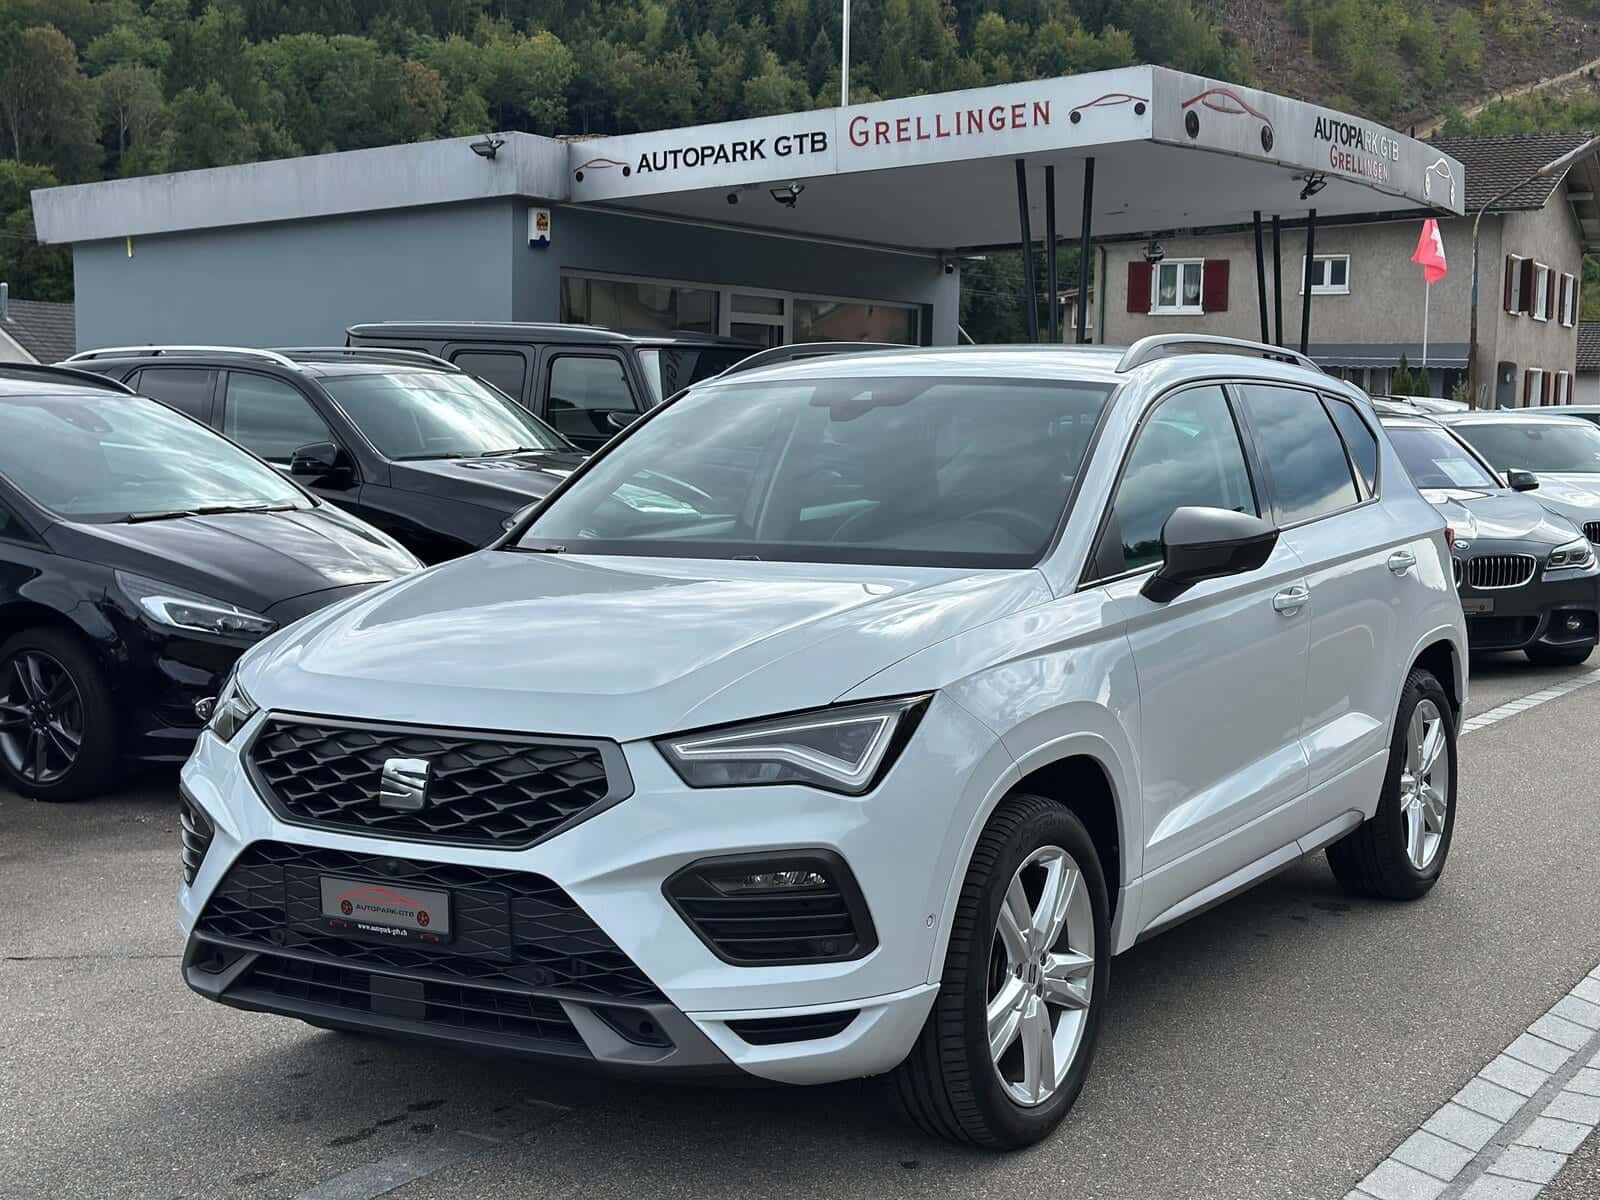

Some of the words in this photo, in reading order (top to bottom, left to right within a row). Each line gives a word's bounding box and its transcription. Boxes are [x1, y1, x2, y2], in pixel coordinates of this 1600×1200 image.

[849, 100, 1051, 147] GRELLINGEN
[1313, 116, 1378, 154] AUTOPARK
[1380, 136, 1399, 161] GTB
[636, 138, 766, 174] AUTOPARK
[773, 131, 828, 157] GTB
